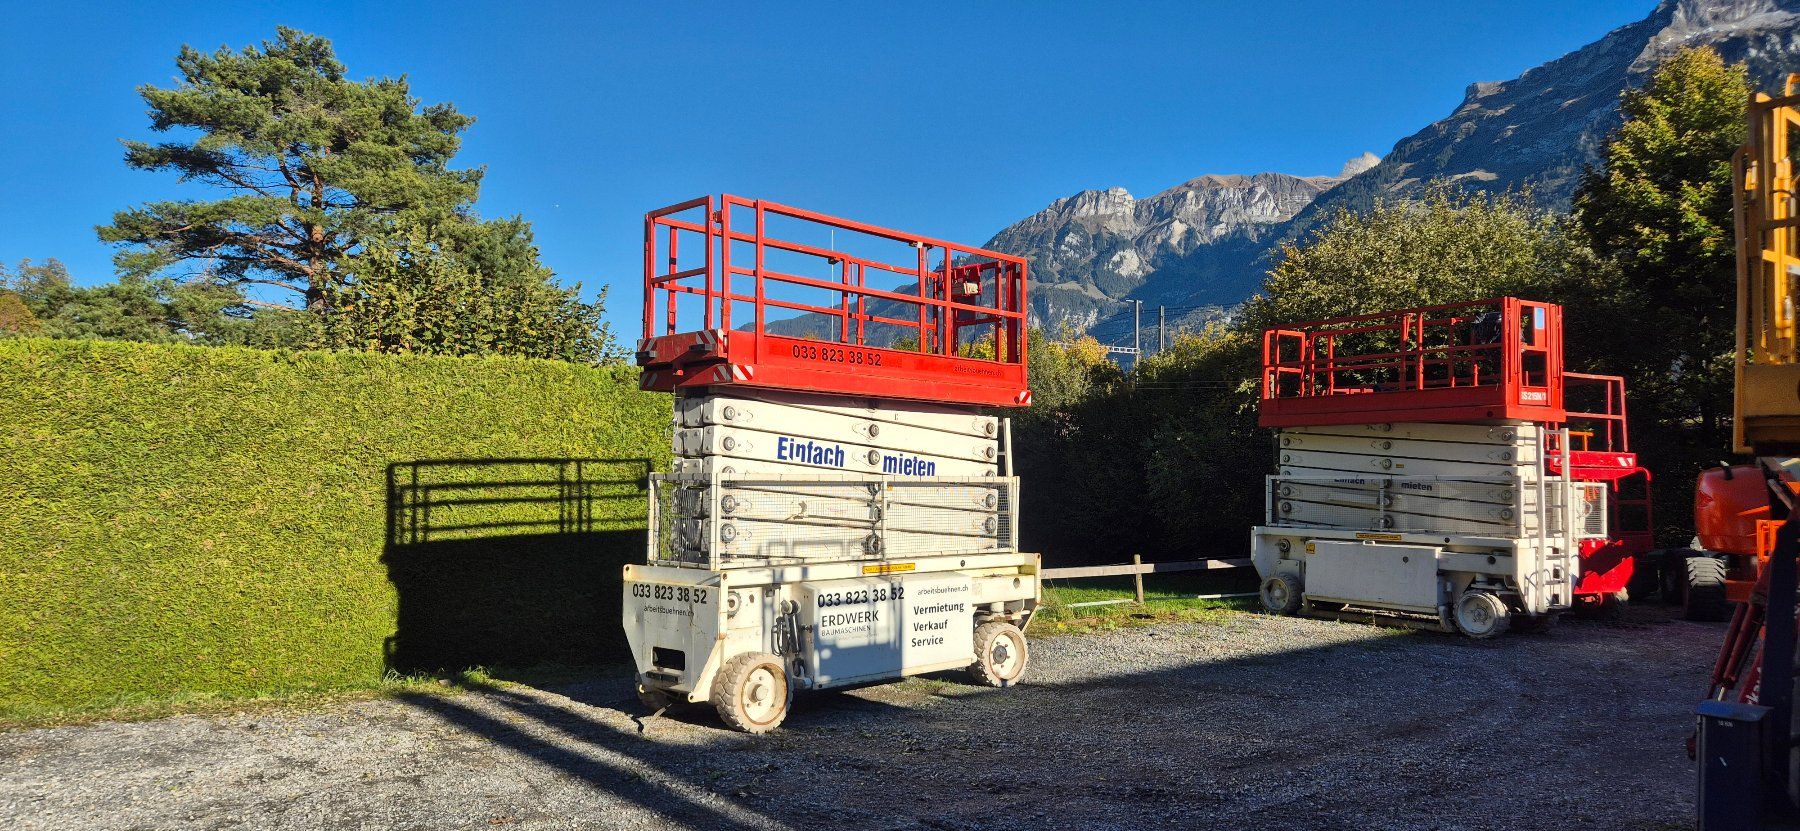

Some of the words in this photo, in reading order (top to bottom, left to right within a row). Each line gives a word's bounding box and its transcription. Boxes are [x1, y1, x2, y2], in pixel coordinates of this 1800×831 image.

[792, 344, 817, 360] 033
[821, 347, 844, 363] 823
[848, 350, 863, 365] 38
[867, 353, 882, 367] 52
[777, 436, 845, 468] Einfach
[882, 453, 936, 477] mieten
[1401, 481, 1433, 492] mieten
[632, 583, 651, 599] 033
[654, 584, 674, 601] 823
[676, 586, 690, 603] 38
[693, 588, 708, 605] 52
[917, 583, 969, 596] arbeitsbuehnen.ch
[817, 592, 842, 608] 033
[845, 589, 869, 605] 823
[872, 588, 888, 603] 38
[890, 586, 905, 601] 52
[913, 602, 965, 616] Vermietung
[821, 609, 880, 628] ERDWERK
[913, 618, 949, 632] Verkauf
[821, 625, 871, 637] BAUMASCHINEN
[911, 634, 944, 648] Service
